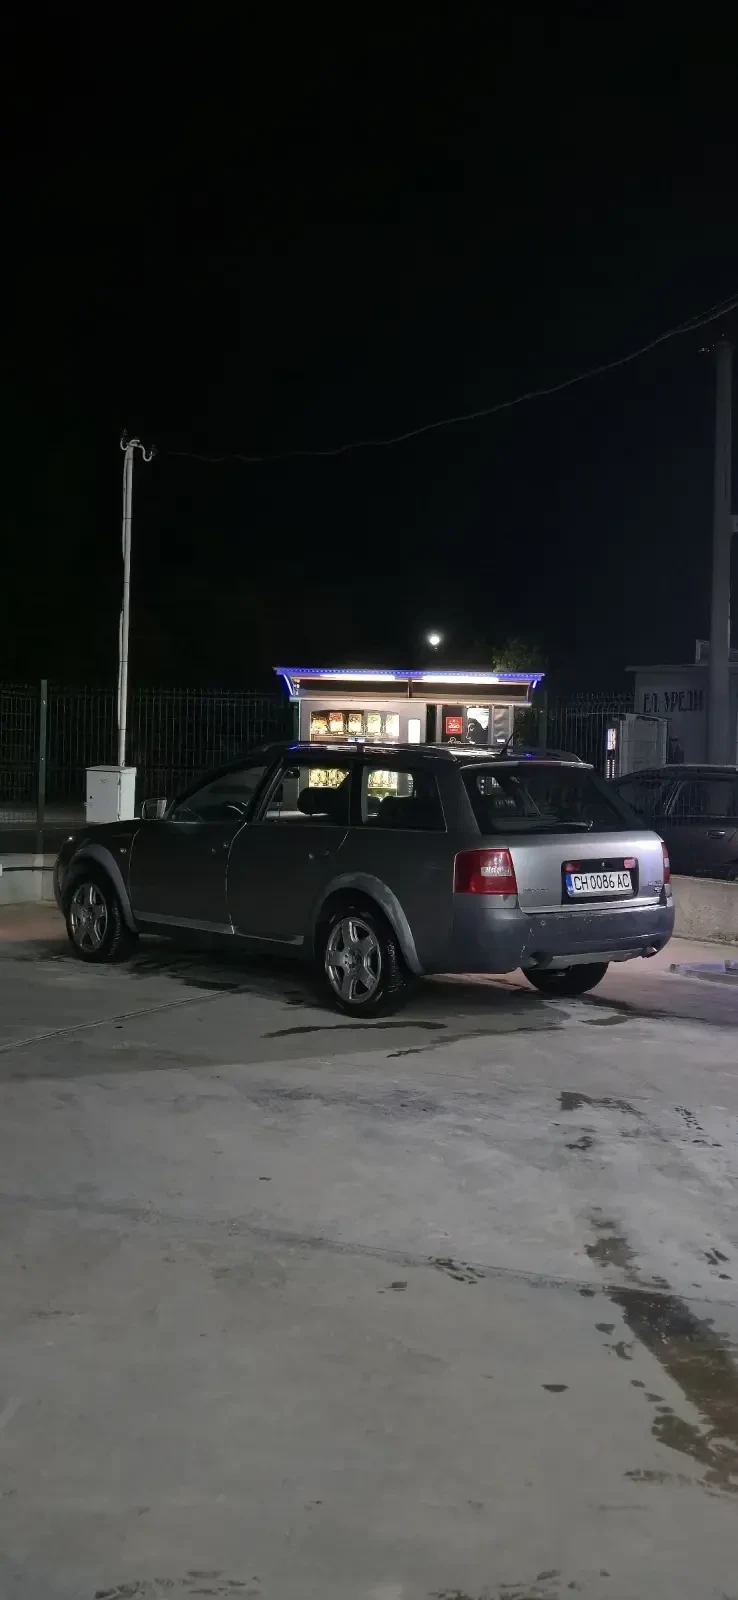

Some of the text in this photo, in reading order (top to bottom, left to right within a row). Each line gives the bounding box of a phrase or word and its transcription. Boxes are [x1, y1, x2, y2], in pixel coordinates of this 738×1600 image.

[574, 876, 588, 890] CH
[590, 874, 615, 889] 0086
[617, 873, 630, 888] AC
